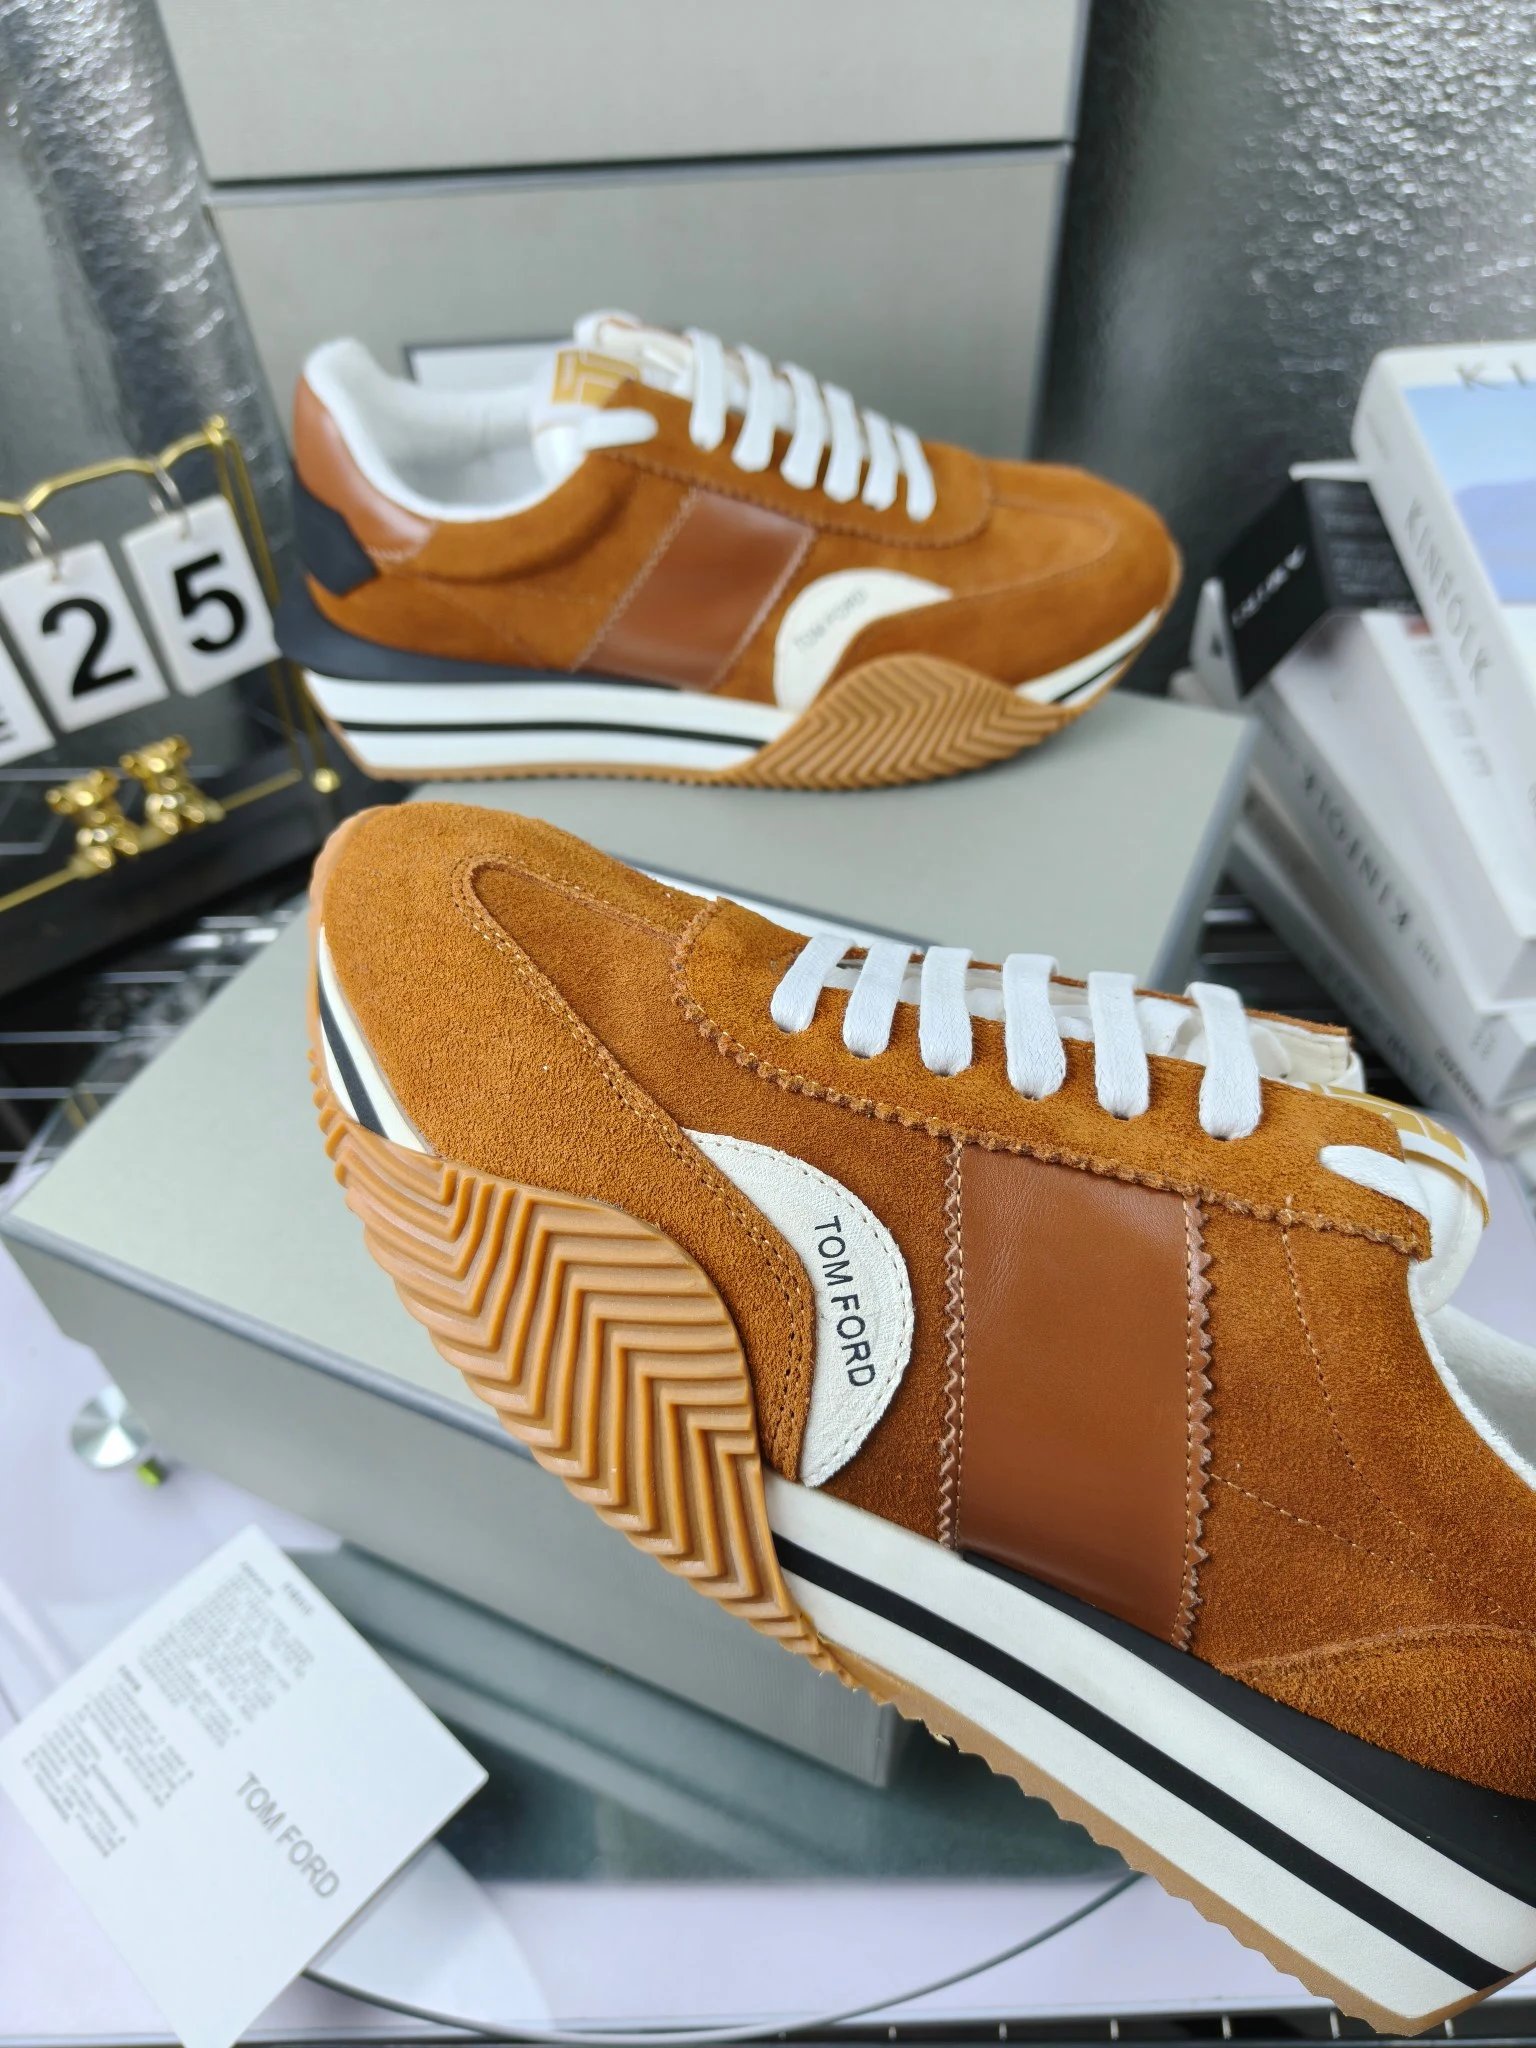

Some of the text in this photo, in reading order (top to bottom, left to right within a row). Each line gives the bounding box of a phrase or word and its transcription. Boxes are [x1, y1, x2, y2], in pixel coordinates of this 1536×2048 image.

[814, 1215, 876, 1388] TOM FORD
[236, 1771, 341, 1899] TOM FORD
